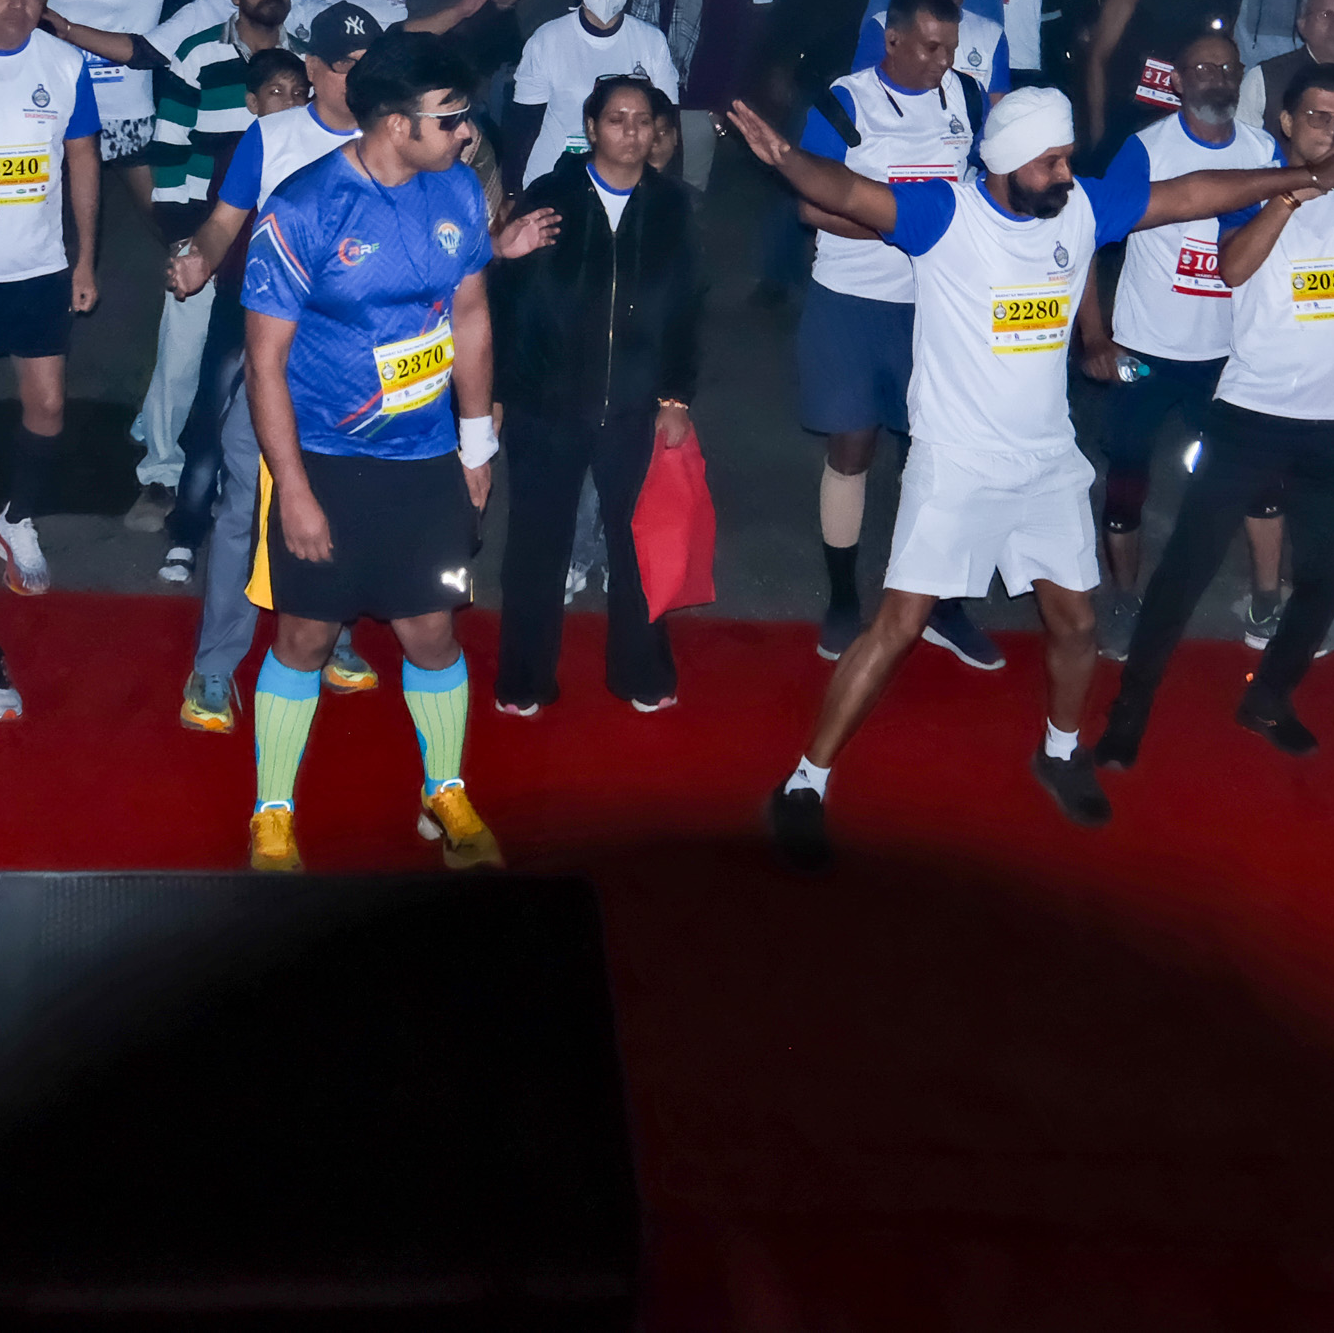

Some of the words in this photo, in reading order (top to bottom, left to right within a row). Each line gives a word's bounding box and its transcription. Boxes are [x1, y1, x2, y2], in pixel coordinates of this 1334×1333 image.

[344, 15, 366, 35] NY
[1194, 254, 1218, 272] 10
[1008, 299, 1059, 321] 2280
[397, 344, 443, 379] 2370
